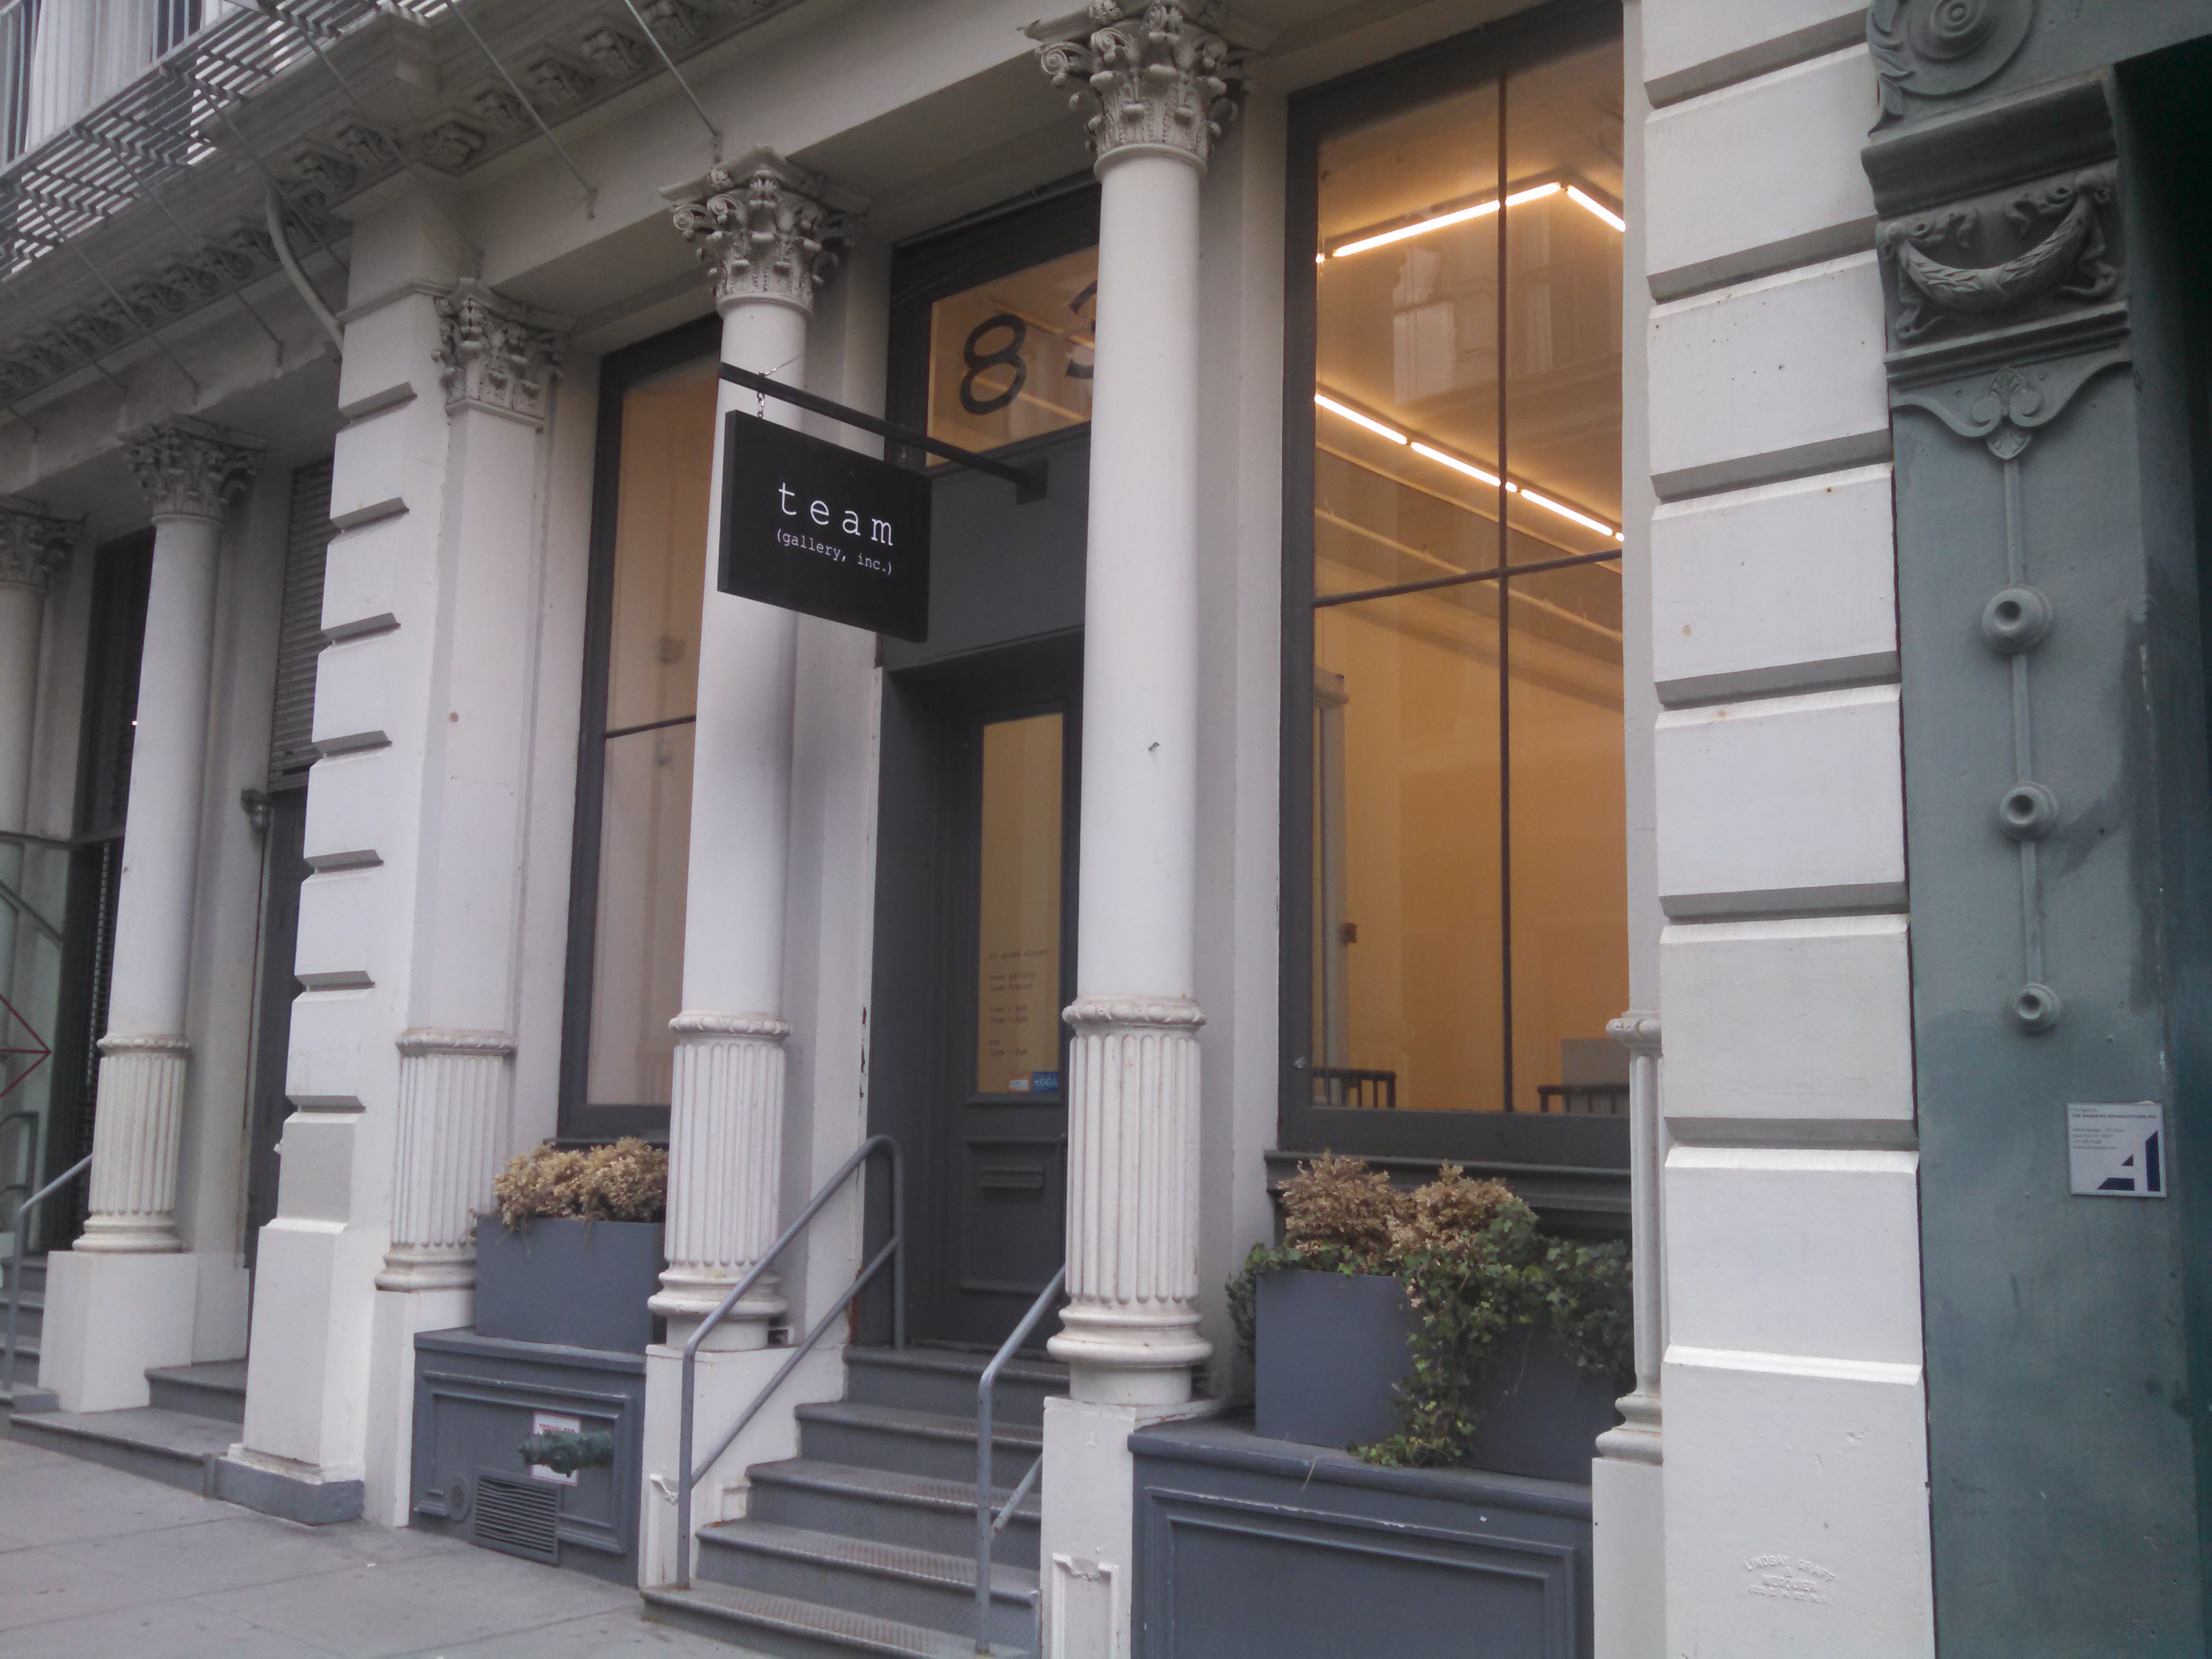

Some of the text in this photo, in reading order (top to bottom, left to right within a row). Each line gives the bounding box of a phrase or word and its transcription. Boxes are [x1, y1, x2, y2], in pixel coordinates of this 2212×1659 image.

[778, 482, 894, 546] team
[777, 529, 893, 575] (gallery, inc.)
[1024, 949, 1048, 957] street
[1008, 970, 1036, 982] gallery
